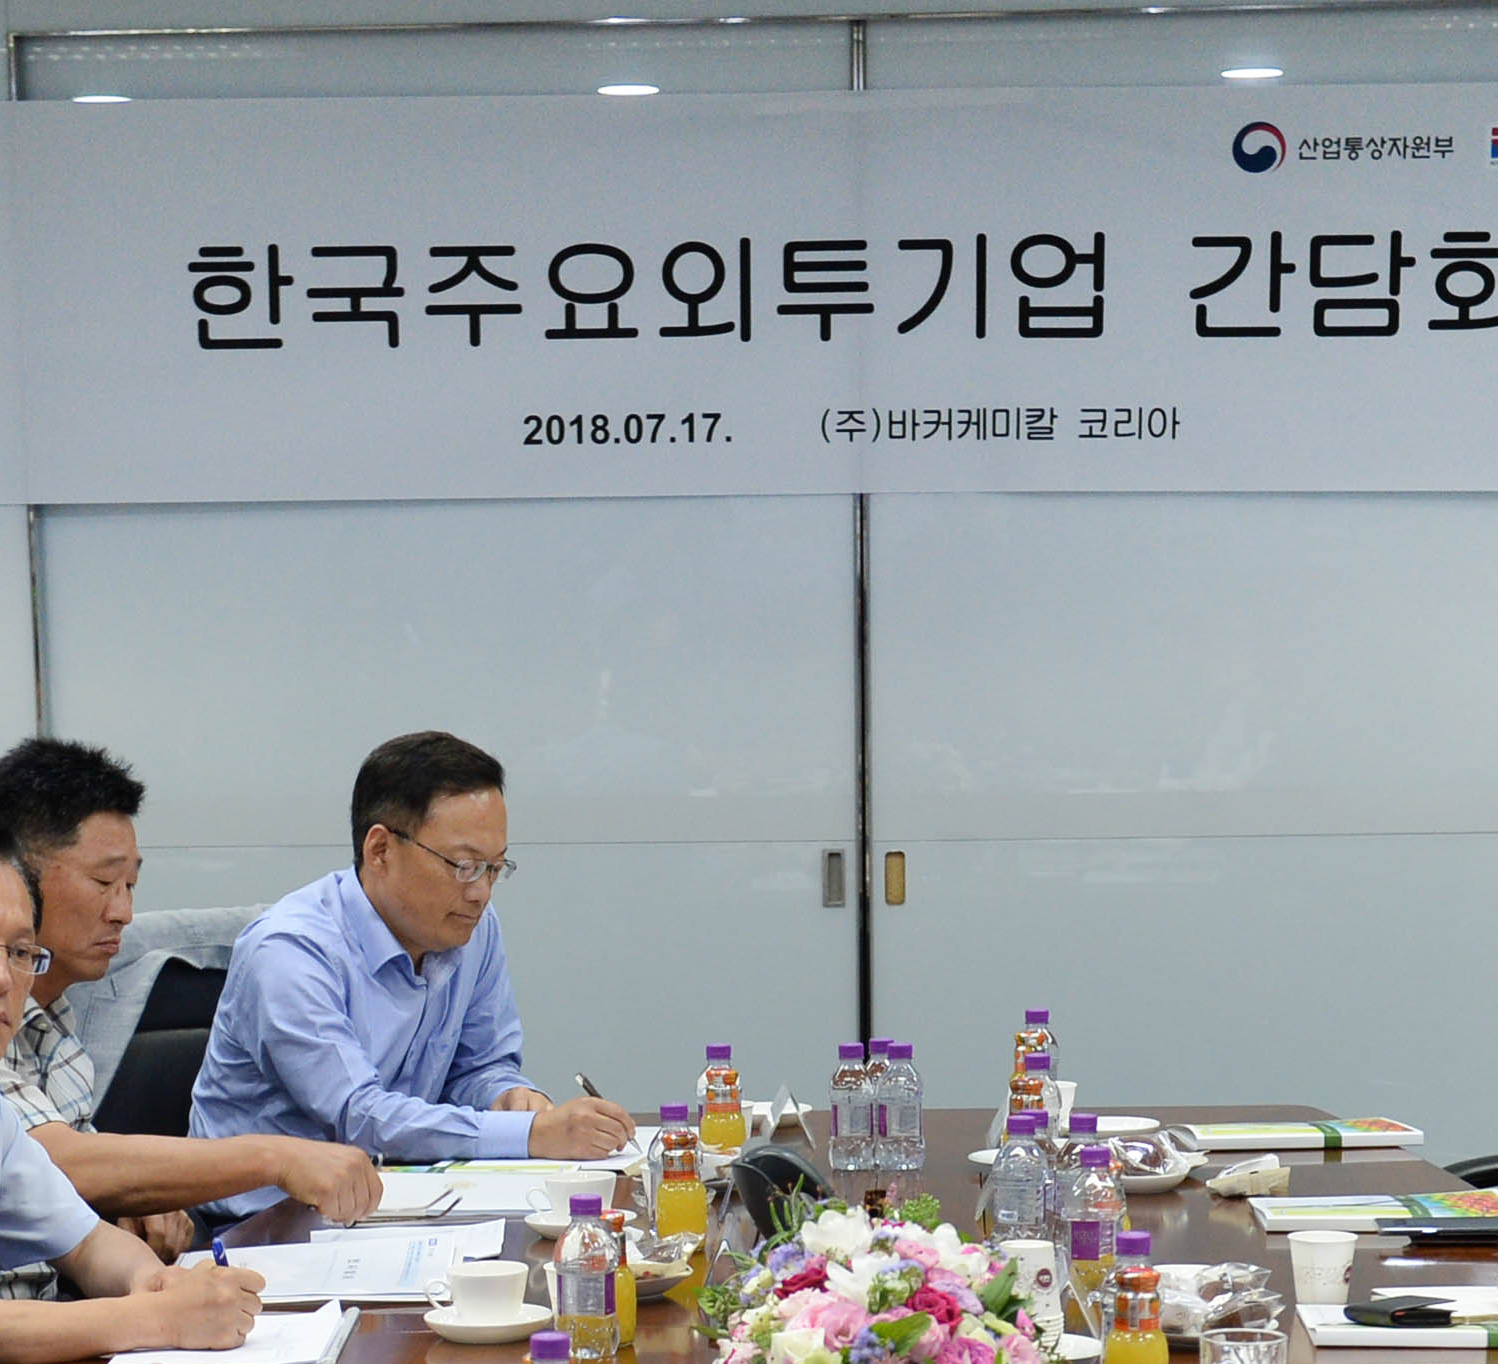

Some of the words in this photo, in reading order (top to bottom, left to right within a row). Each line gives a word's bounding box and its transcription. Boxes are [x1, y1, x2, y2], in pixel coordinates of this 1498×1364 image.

[1298, 135, 1455, 161] 산업통상자원부
[187, 231, 1107, 350] 한국주요외투기업
[523, 412, 732, 446] 2018.07.17.
[820, 407, 1059, 444] (주)바커케미칼
[1078, 406, 1182, 440] 코리아
